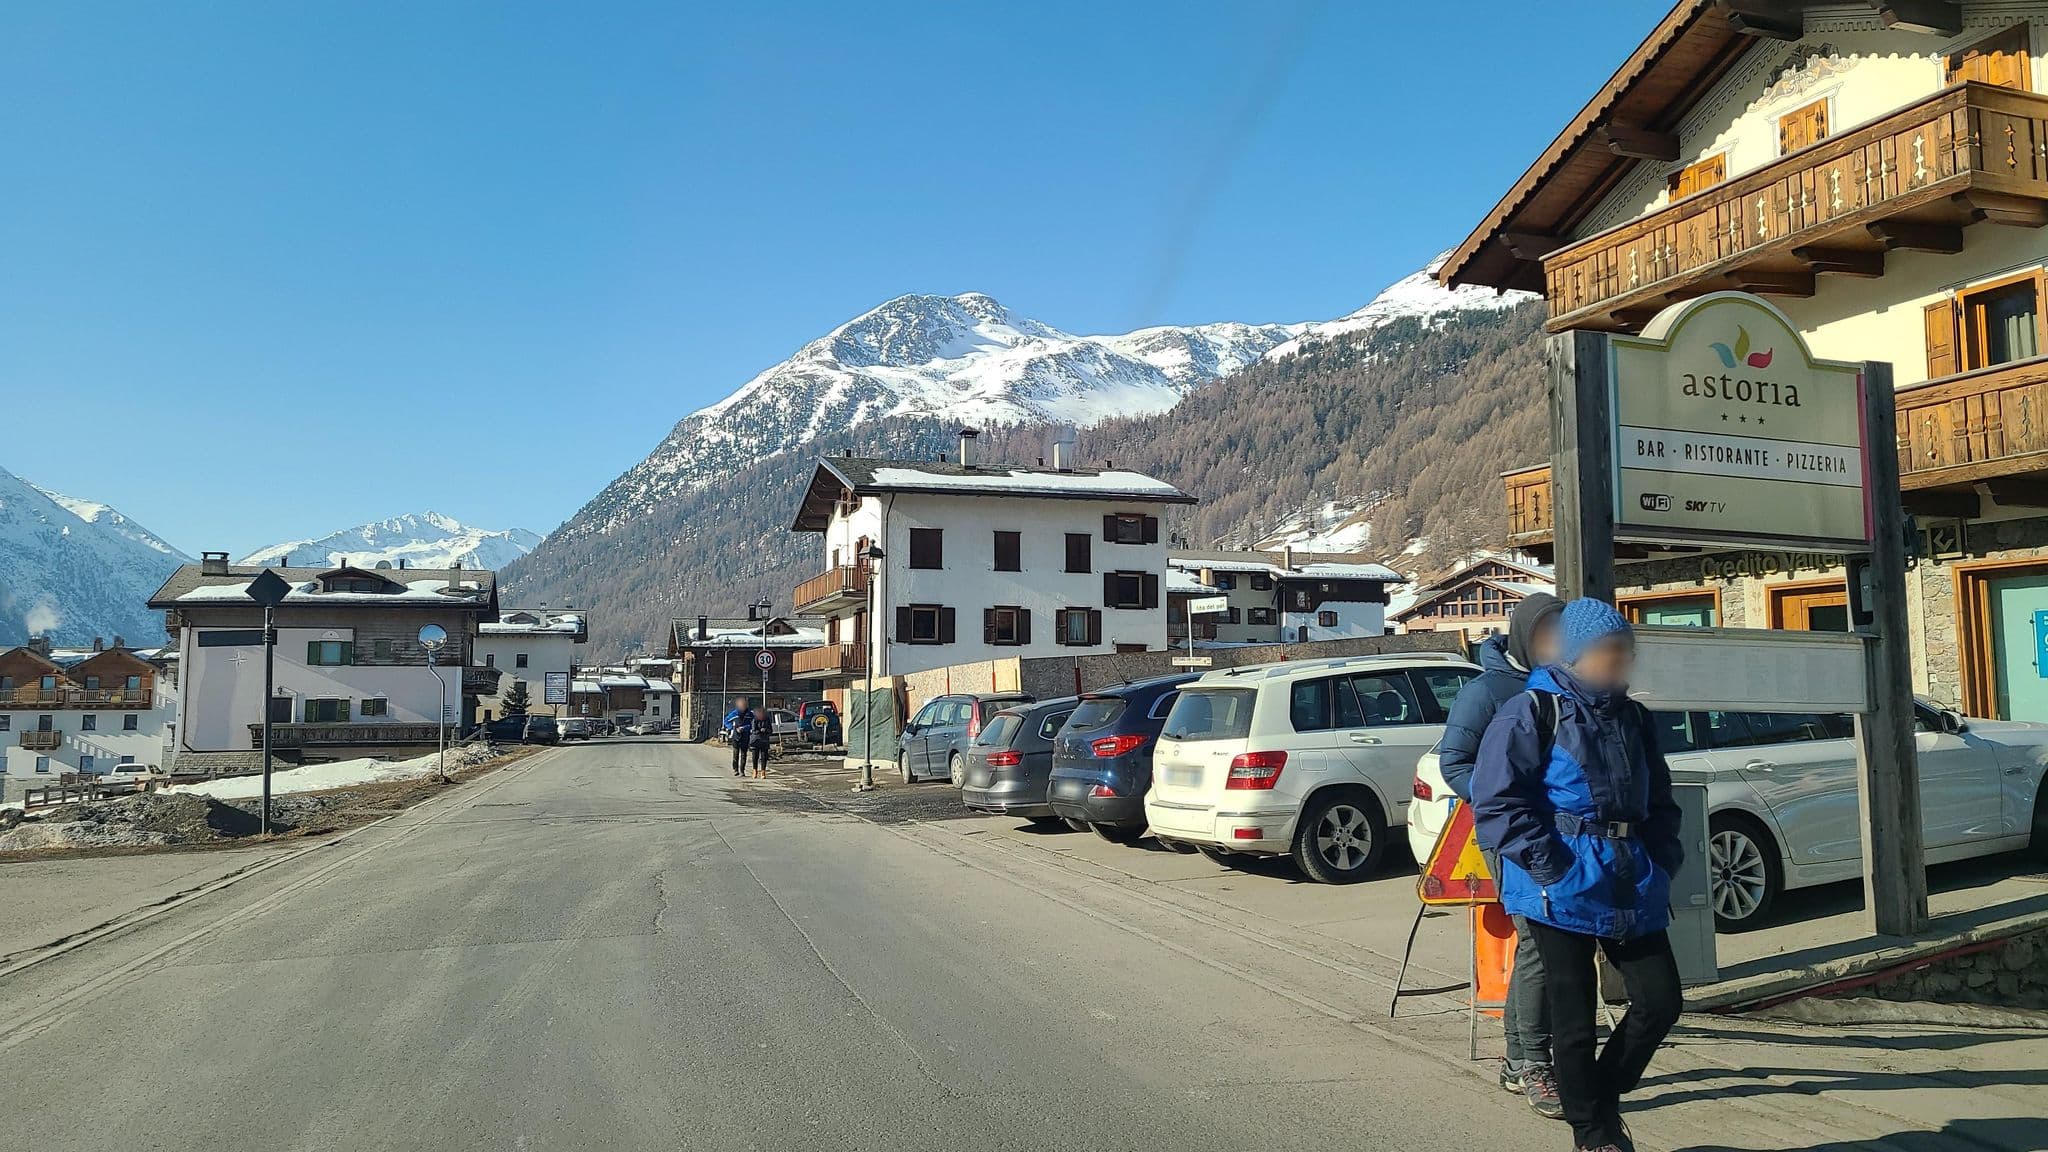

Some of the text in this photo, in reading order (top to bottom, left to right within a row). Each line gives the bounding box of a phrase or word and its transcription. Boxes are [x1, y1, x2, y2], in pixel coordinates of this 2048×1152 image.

[1682, 373, 1801, 407] astoria
[1637, 439, 1847, 474] BAR RISTORANTE PIZZERIA
[1685, 500, 1708, 512] SKY
[1710, 502, 1726, 513] TV
[1700, 553, 1778, 579] Credito
[759, 655, 772, 665] 30
